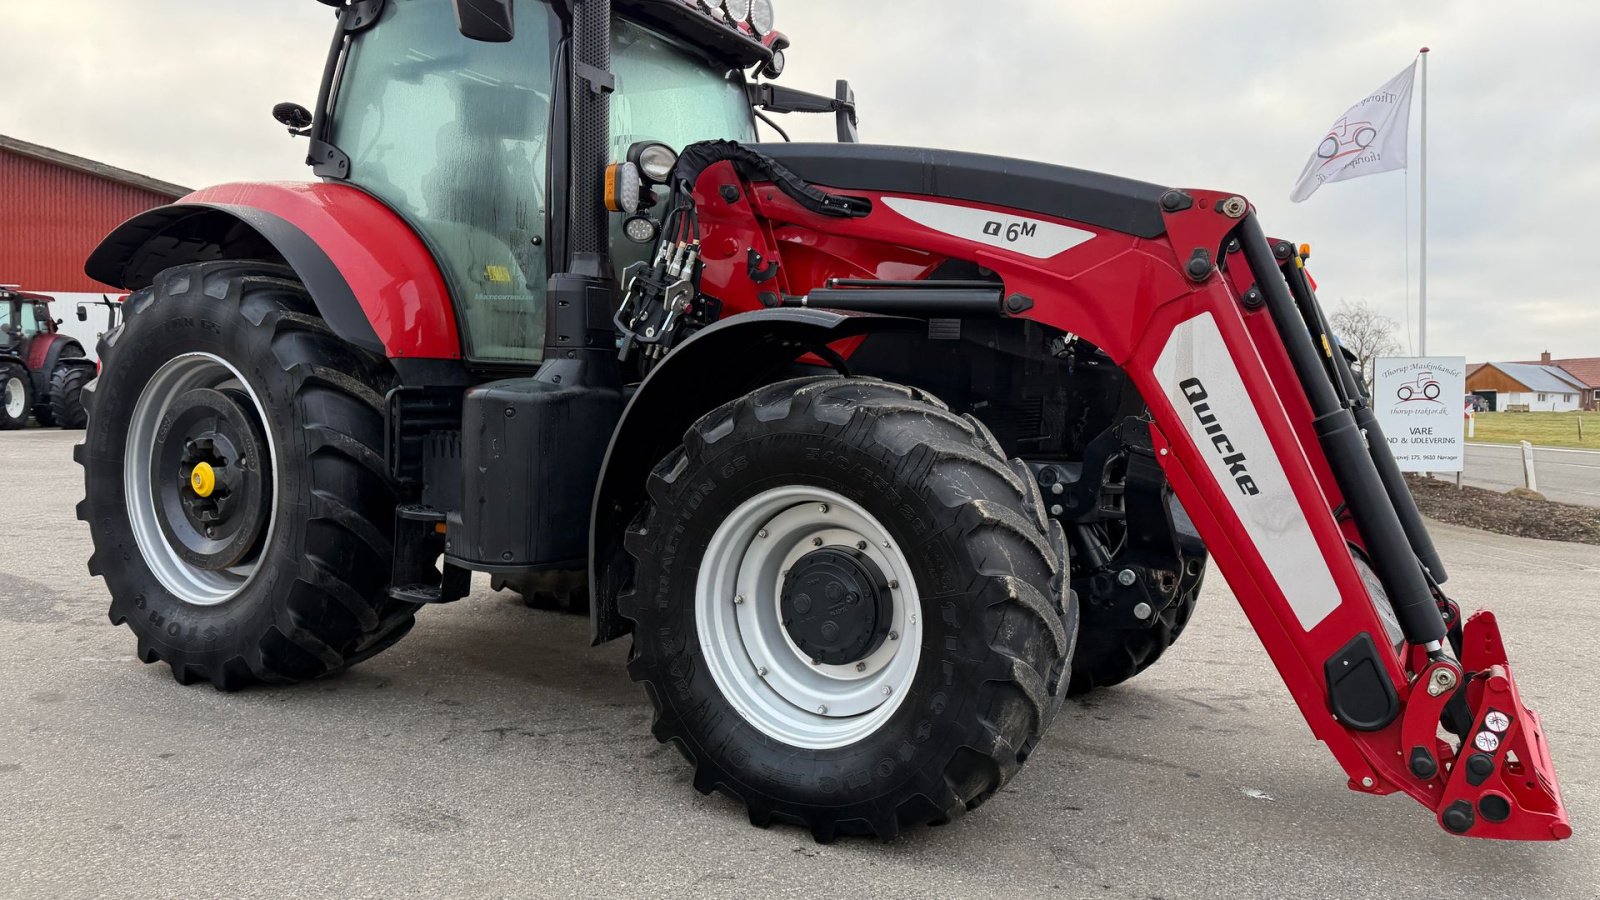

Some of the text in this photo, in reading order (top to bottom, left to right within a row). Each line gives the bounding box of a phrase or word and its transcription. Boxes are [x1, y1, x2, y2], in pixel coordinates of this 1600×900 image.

[1382, 361, 1462, 379] Thorup Maskinhandel
[1390, 407, 1449, 417] thorup-traktor.dk
[1179, 377, 1260, 496] Quicke
[1409, 427, 1433, 435] VARE
